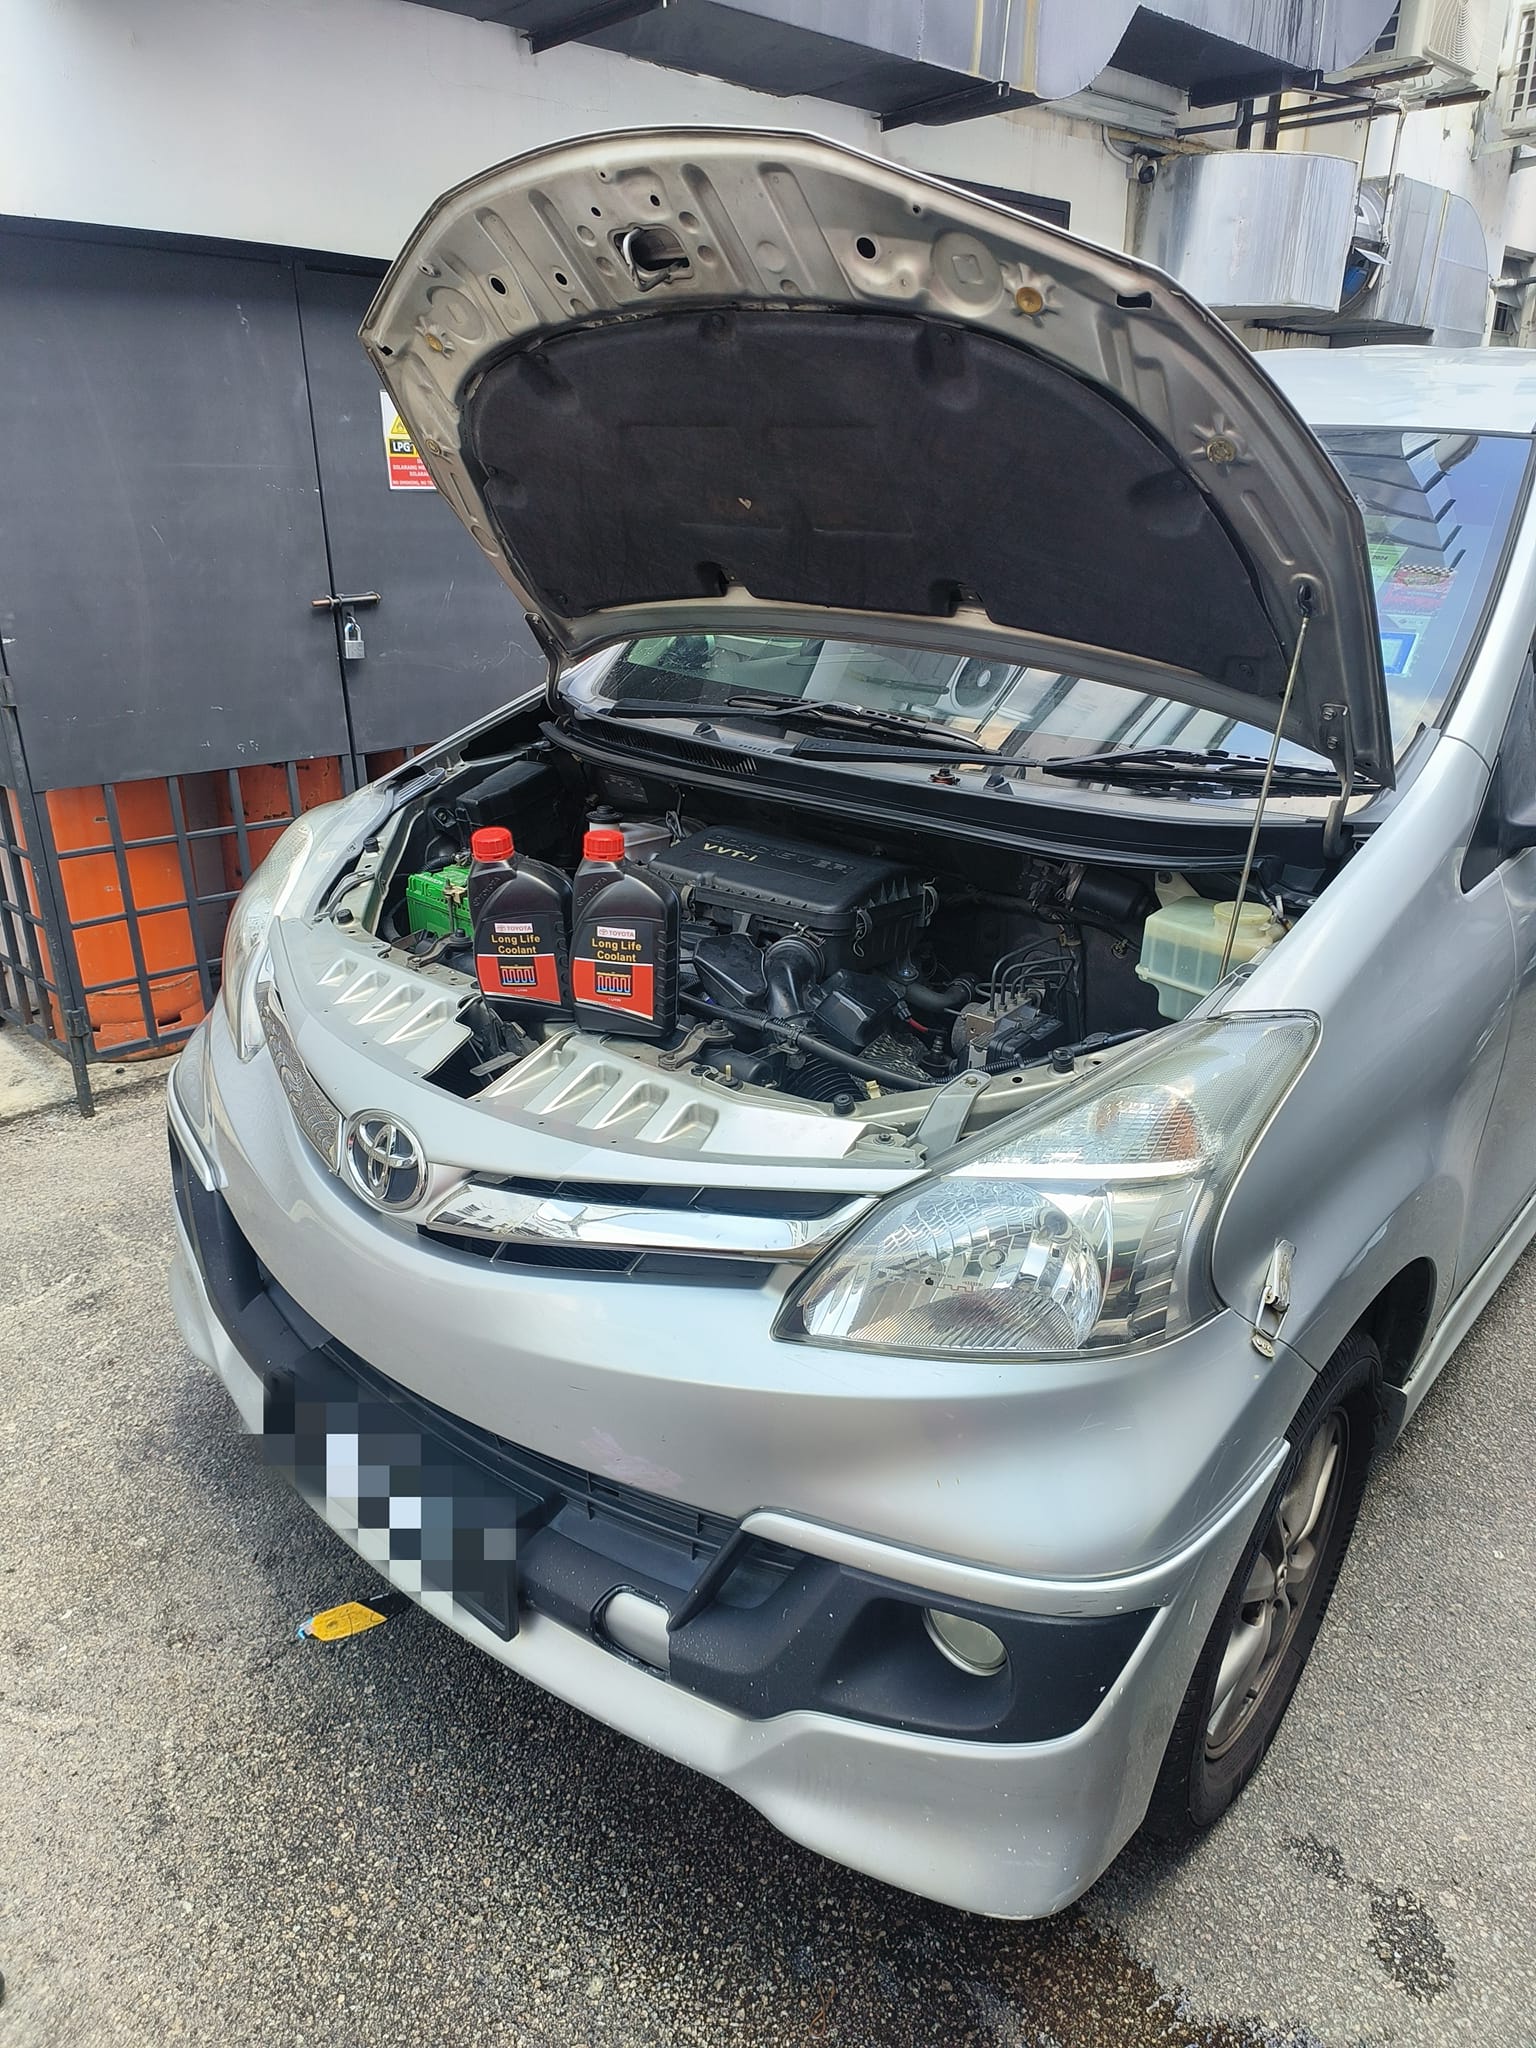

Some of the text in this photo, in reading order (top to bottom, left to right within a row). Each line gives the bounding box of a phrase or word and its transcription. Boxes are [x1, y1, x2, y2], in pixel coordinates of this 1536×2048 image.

[393, 442, 411, 452] LPG
[609, 930, 635, 938] TOYOTA
[491, 934, 541, 945] Long Life
[591, 938, 642, 951] Long Life
[498, 945, 537, 954] Coolant
[597, 950, 637, 962] Coolant
